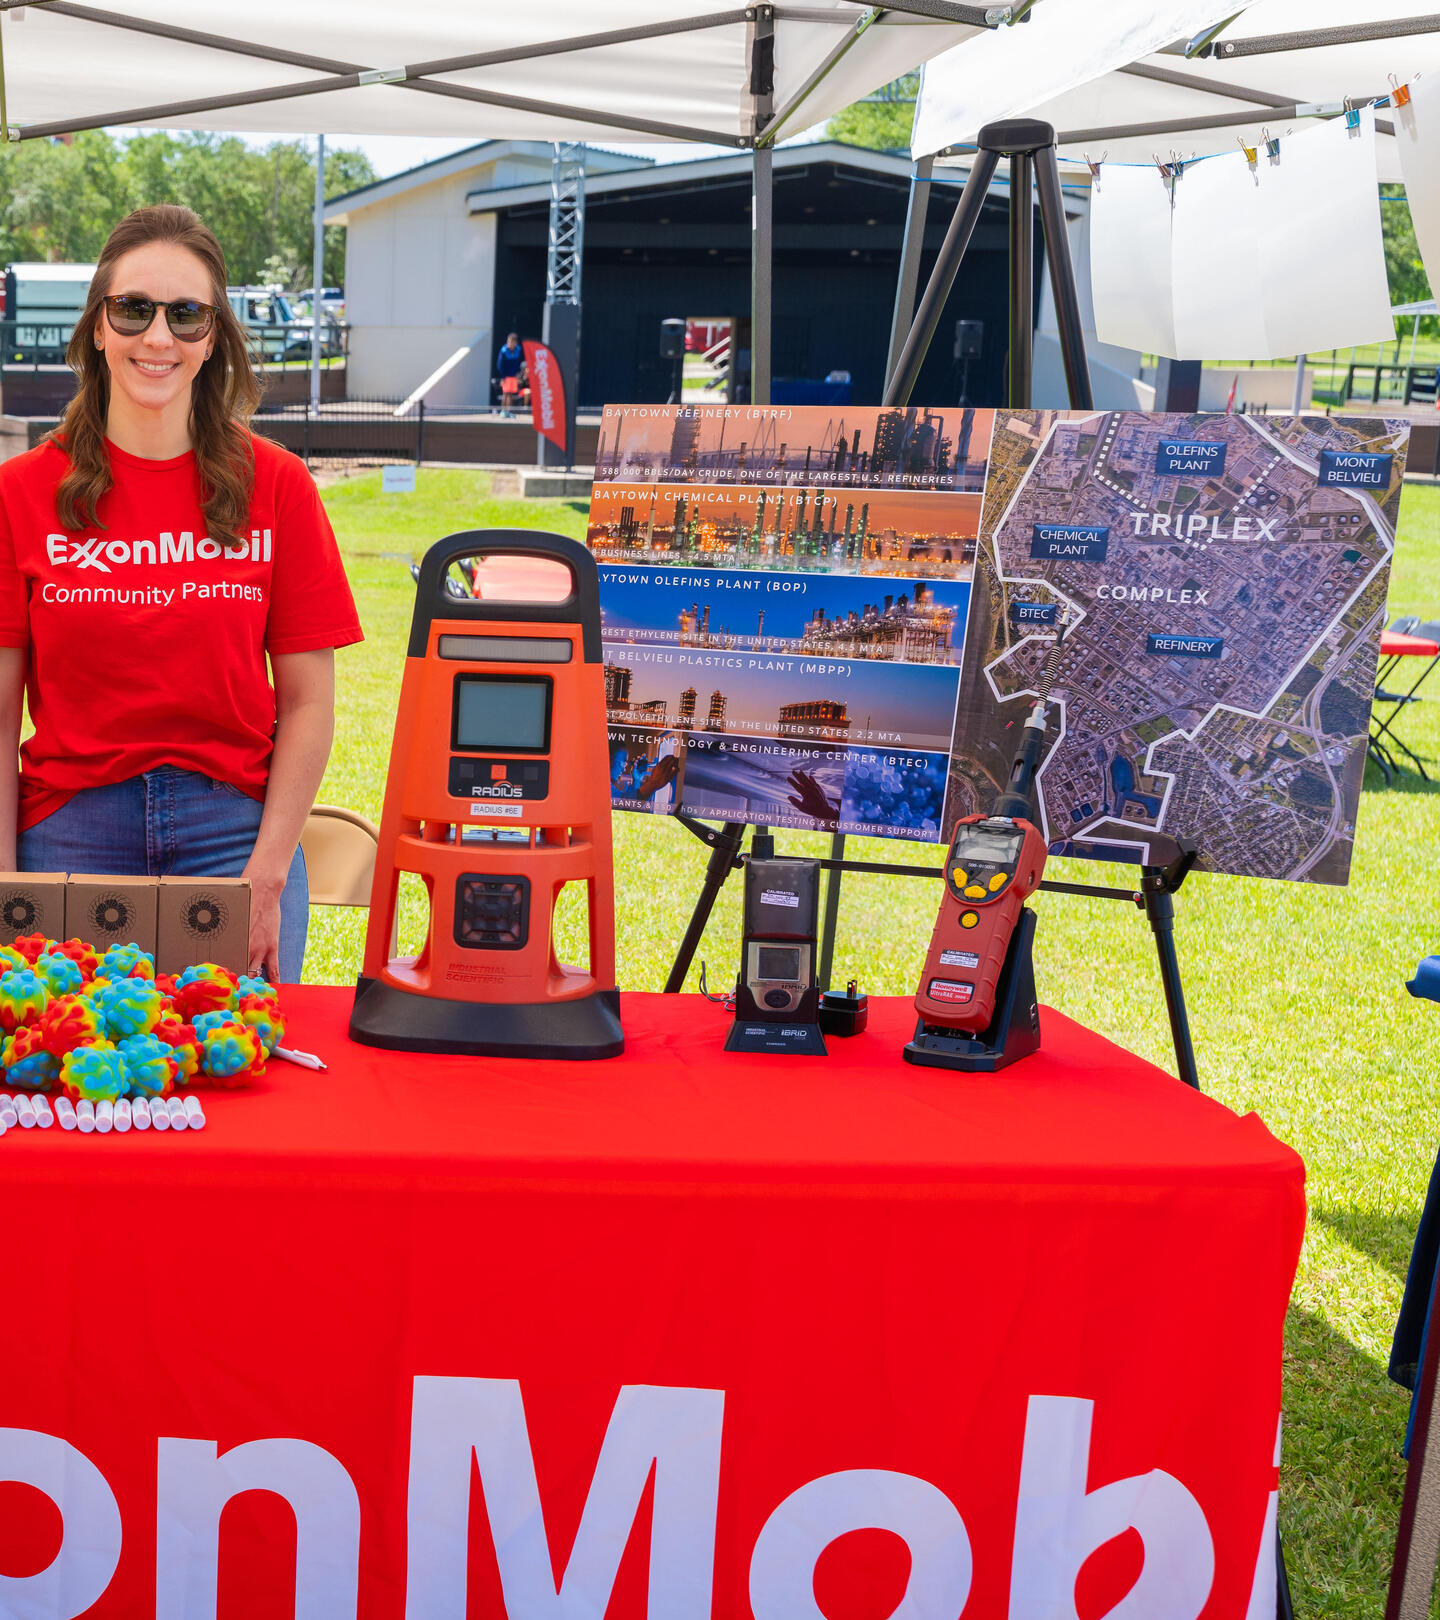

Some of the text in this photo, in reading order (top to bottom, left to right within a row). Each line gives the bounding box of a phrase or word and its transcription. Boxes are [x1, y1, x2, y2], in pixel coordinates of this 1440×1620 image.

[605, 408, 792, 421] BAYTOWN REFINERY (BTRF)
[1165, 444, 1219, 458] OLEFINS
[1169, 458, 1211, 470] PLANT
[1335, 456, 1378, 469] MONT
[602, 467, 953, 484] 588,000 BBLS/DAY CRUDE, ONE OF THE LARGEST U.S. REFINERIES
[1327, 470, 1382, 485] BELVIEU
[594, 490, 838, 508] BAYTOWN CHEMICAL PLANT (BTCP)
[1129, 511, 1278, 542] TRIPLEX
[1040, 529, 1101, 543] CHEMICAL
[46, 529, 272, 573] ExxonMobil
[598, 549, 648, 559] BUSINESS
[652, 552, 684, 561] LINES,
[713, 554, 735, 563] MTA
[1049, 543, 1089, 556] PLANT
[598, 574, 807, 595] YTOWN OLEFINS PLANT (BOP)
[42, 580, 263, 607] Community Partners
[1096, 584, 1210, 606] COMPLEX
[1018, 606, 1049, 620] BTEC
[601, 628, 883, 653] GEST ETHYLENE SITE IN THE UNITED STATES, 4.5 MTA
[1154, 638, 1215, 653] REFINERY
[619, 651, 673, 664] BELVIEU
[679, 655, 743, 668] PLASTICS
[749, 660, 794, 672] PLANT
[799, 662, 852, 678] (MBPP)
[619, 711, 696, 725] POLYETHYLENE
[699, 718, 722, 727] SITE
[726, 720, 736, 728] IN
[741, 721, 761, 730] THE
[765, 723, 804, 734] UNITED
[808, 726, 852, 738] STATES,
[856, 730, 873, 739] 2.2
[878, 733, 902, 742] MTA
[631, 734, 713, 749] TECHNOLOGY
[718, 741, 727, 750] &
[732, 743, 820, 759] ENGINEERING
[826, 750, 877, 764] CENTER
[882, 755, 929, 770] (BTEC)
[472, 786, 523, 798] RADIUS
[473, 805, 503, 814] RADIUS
[611, 799, 642, 809] LANTS
[681, 805, 698, 815] hDs
[709, 809, 772, 822] APPLICATION
[776, 815, 816, 826] TESTING
[819, 819, 826, 828] &
[829, 821, 883, 834] CUSTOMER
[887, 826, 934, 839] SUPPORT
[448, 962, 506, 975] INDUSTRIAL
[446, 972, 505, 984] SCIENTIFIC
[935, 983, 968, 993] Honeywell
